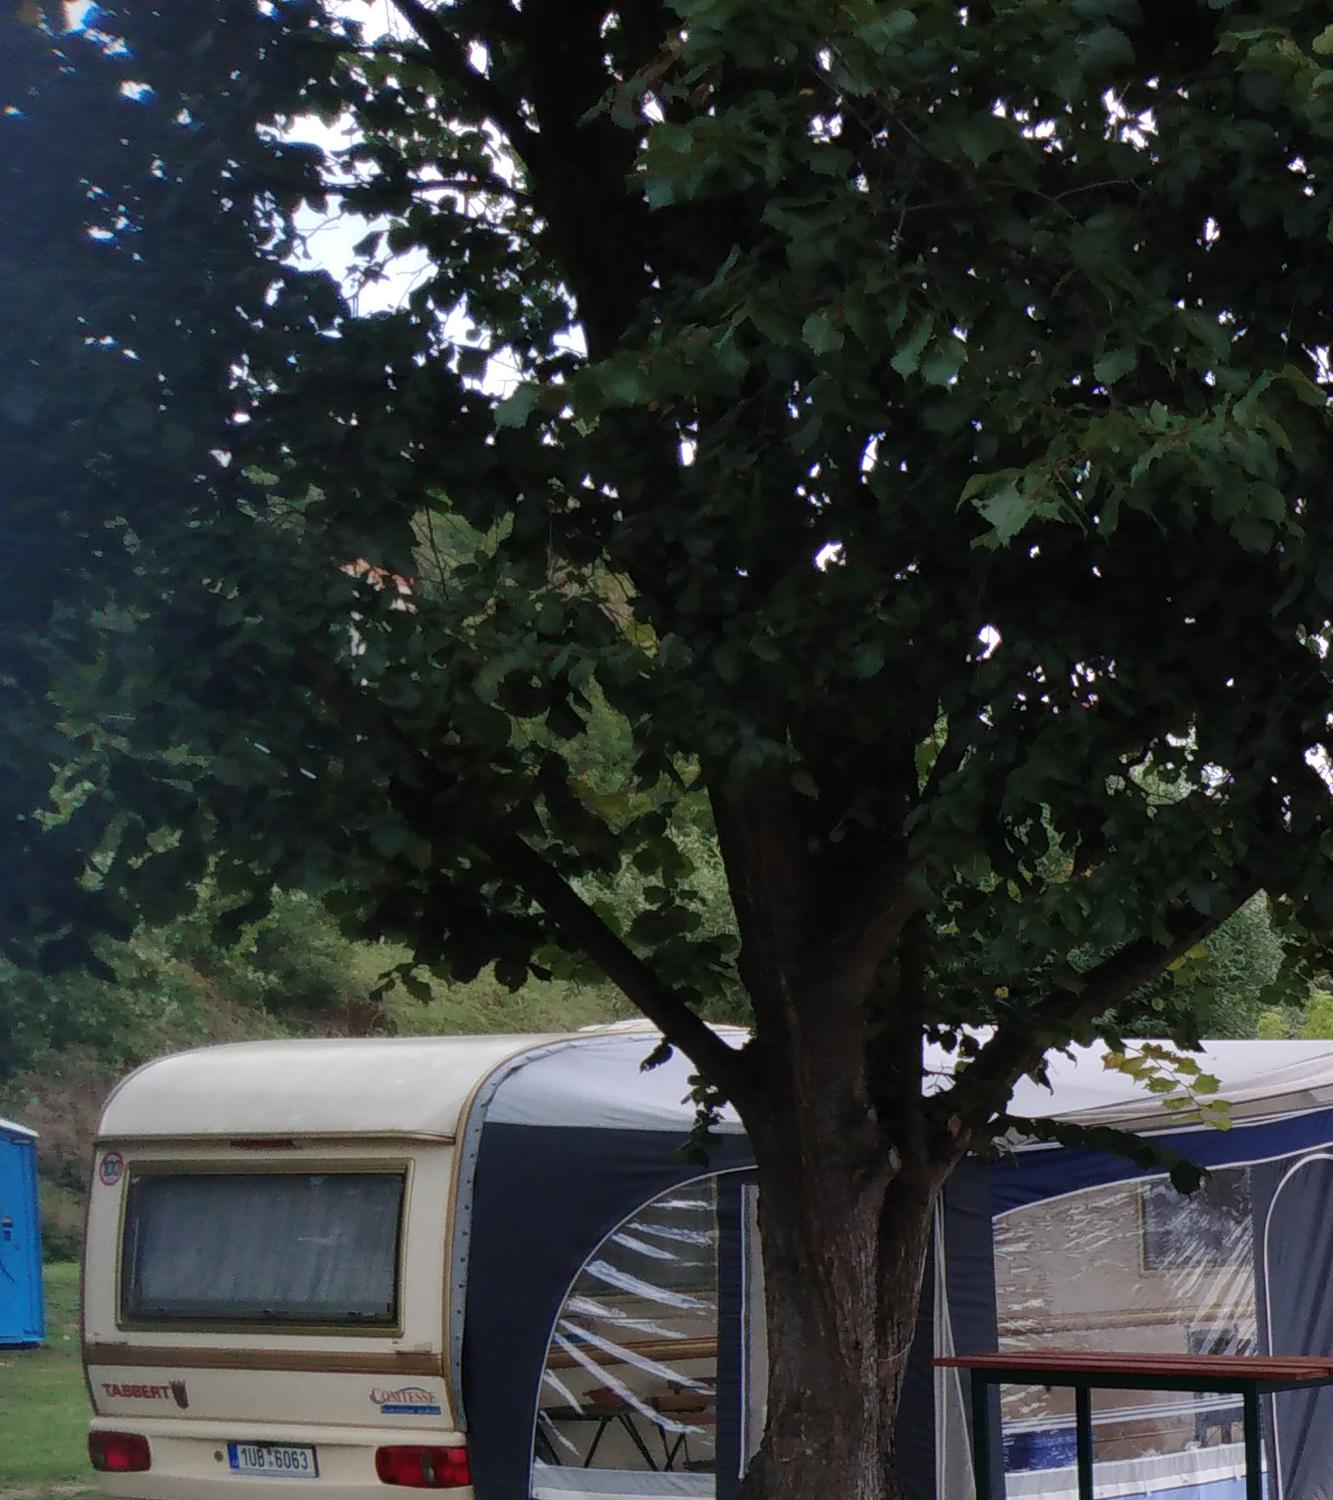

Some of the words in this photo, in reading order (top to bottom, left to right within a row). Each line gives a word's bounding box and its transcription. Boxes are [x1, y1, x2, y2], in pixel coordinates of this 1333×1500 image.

[102, 1383, 169, 1399] TABBERT
[241, 1447, 265, 1468] 1UB
[275, 1449, 309, 1470] 6063
